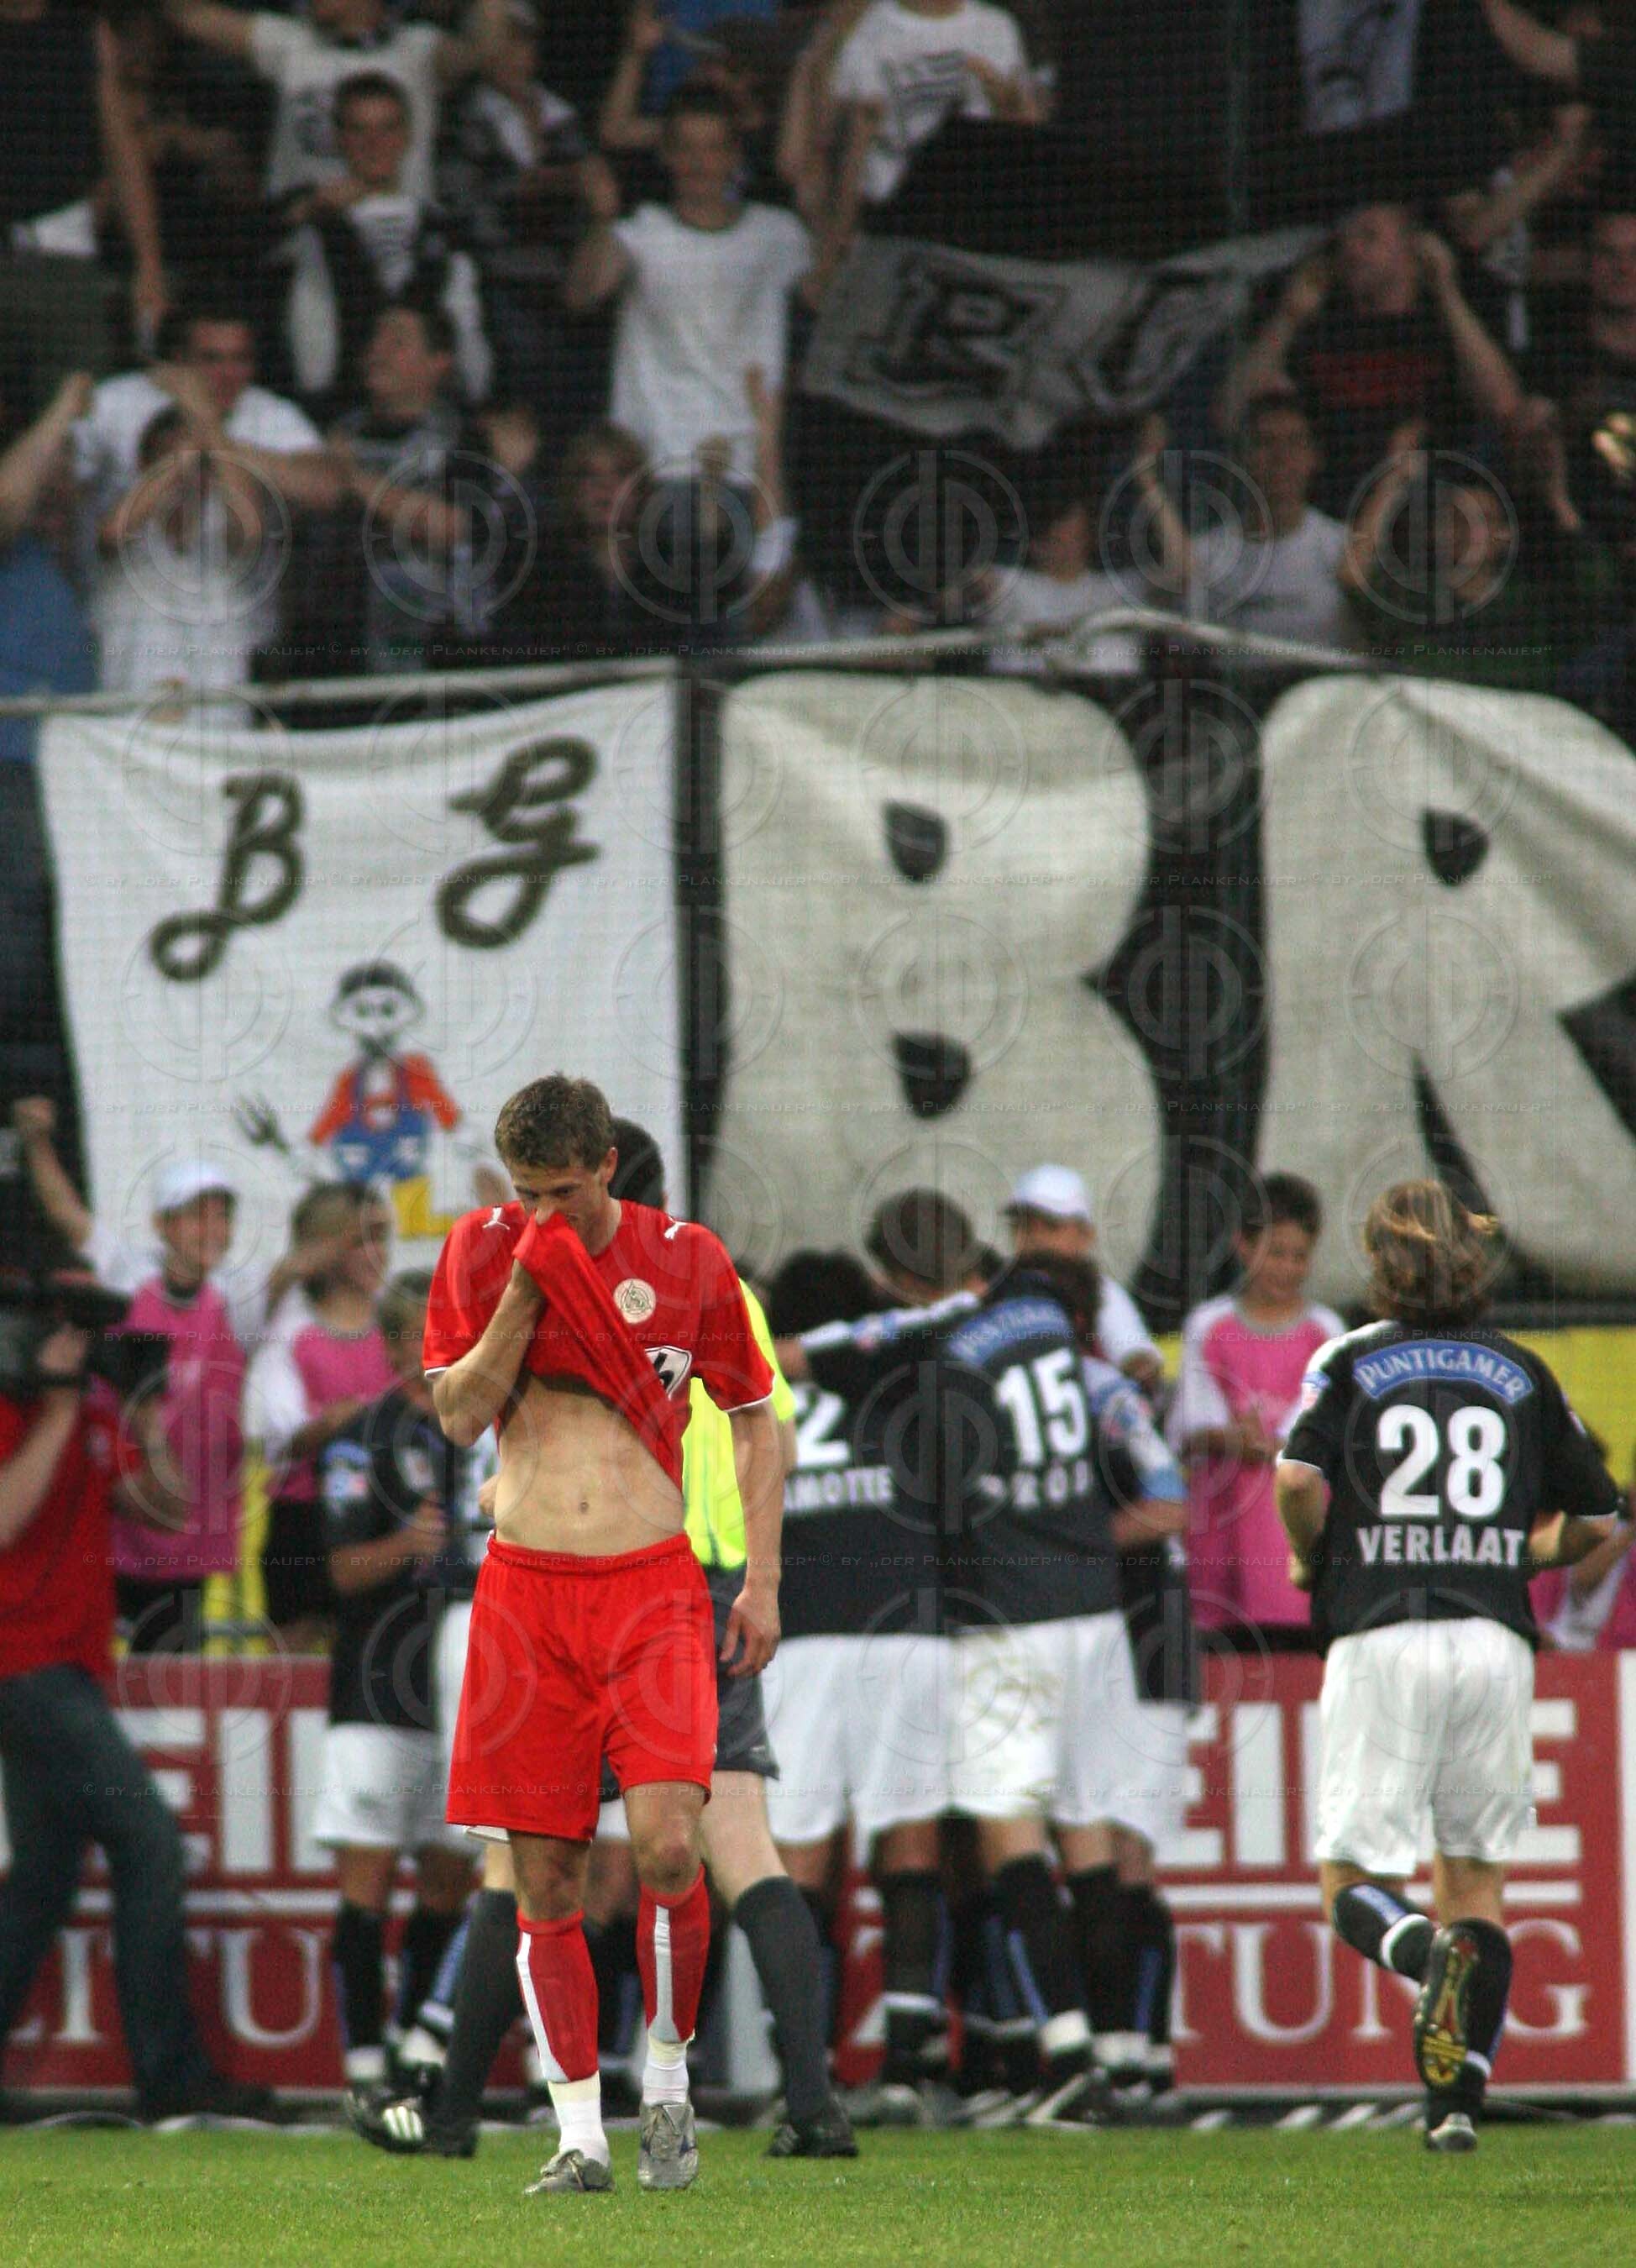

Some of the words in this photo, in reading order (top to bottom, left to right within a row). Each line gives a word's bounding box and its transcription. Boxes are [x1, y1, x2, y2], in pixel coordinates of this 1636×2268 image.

[996, 1347, 1089, 1467] 15
[1356, 1346, 1529, 1400] PUNTIGAMER
[1377, 1403, 1506, 1518] 28
[1355, 1522, 1525, 1568] VERLAAT
